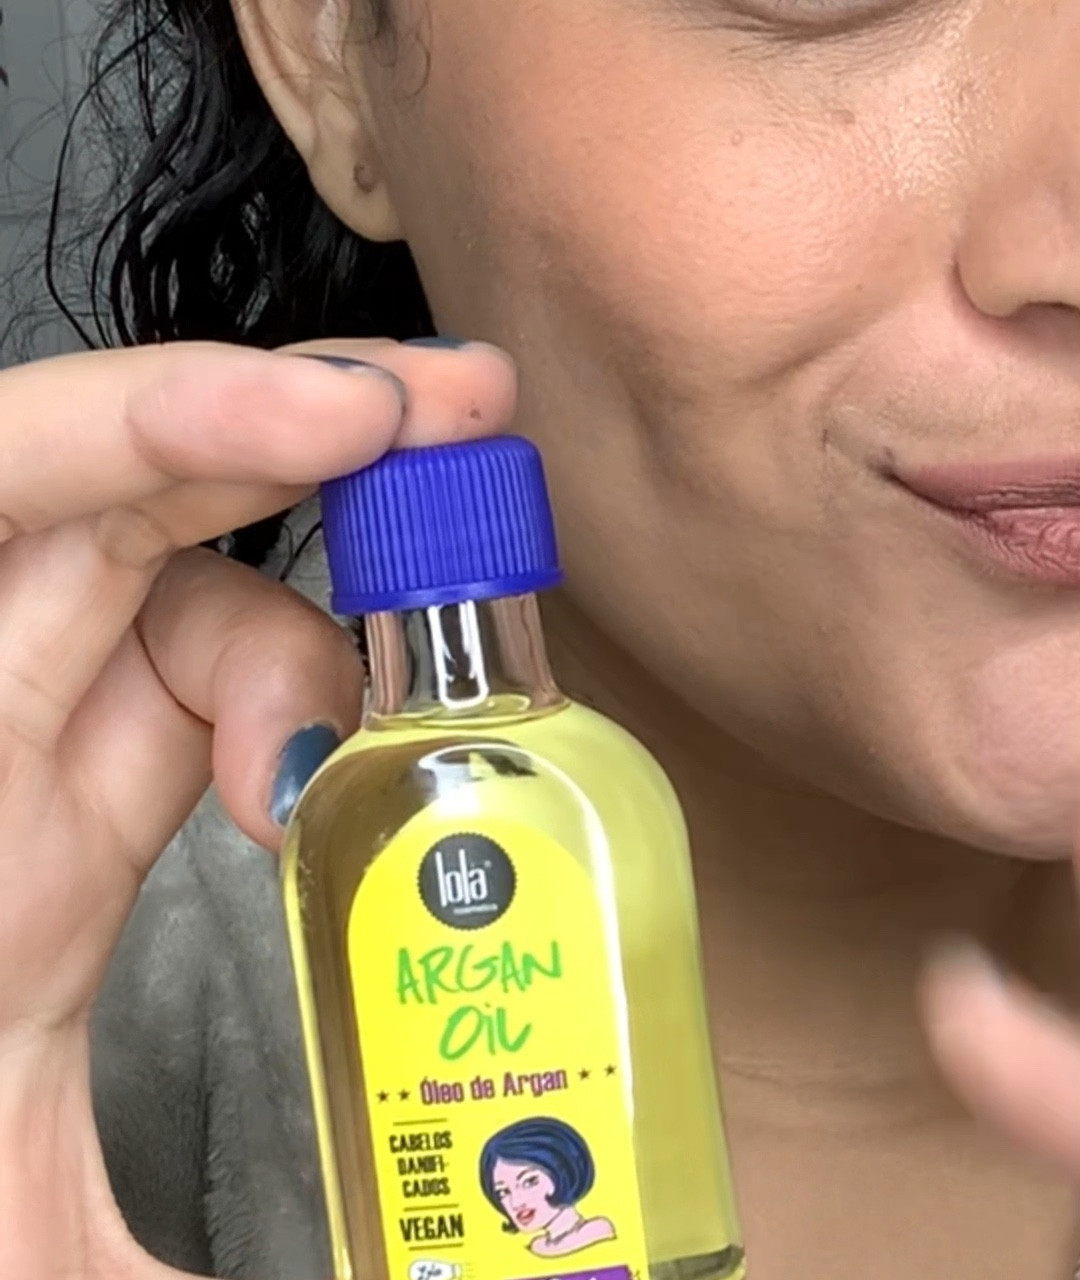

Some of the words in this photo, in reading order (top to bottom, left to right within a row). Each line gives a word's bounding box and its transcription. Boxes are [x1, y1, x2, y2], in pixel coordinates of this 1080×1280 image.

[435, 848, 488, 907] lola
[397, 941, 561, 1004] ARGAN
[420, 1076, 464, 1106] Óleo
[470, 1075, 495, 1100] de
[502, 1069, 568, 1097] Argan
[389, 1130, 453, 1153] CABELOS
[402, 1177, 451, 1198] CADOS
[399, 1213, 464, 1242] VEGAN
